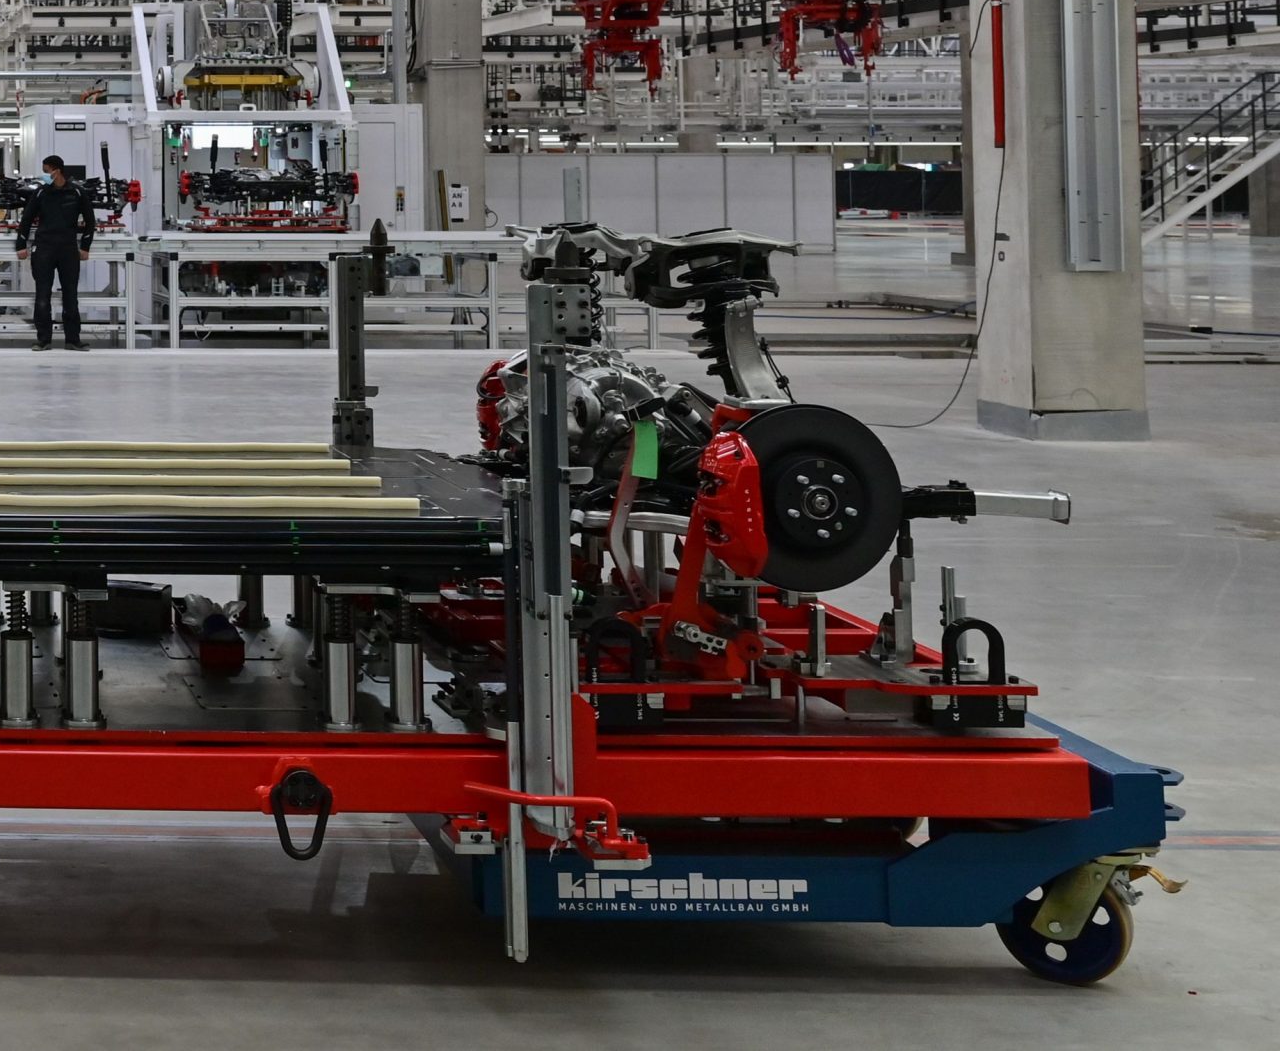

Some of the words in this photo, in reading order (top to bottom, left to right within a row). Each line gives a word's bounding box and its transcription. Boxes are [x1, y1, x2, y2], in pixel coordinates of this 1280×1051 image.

[558, 873, 807, 899] kirschner
[558, 902, 643, 911] MASCHINEN-
[650, 903, 678, 911] UND
[685, 903, 764, 912] METALLBAU
[771, 903, 810, 912] GMBH
